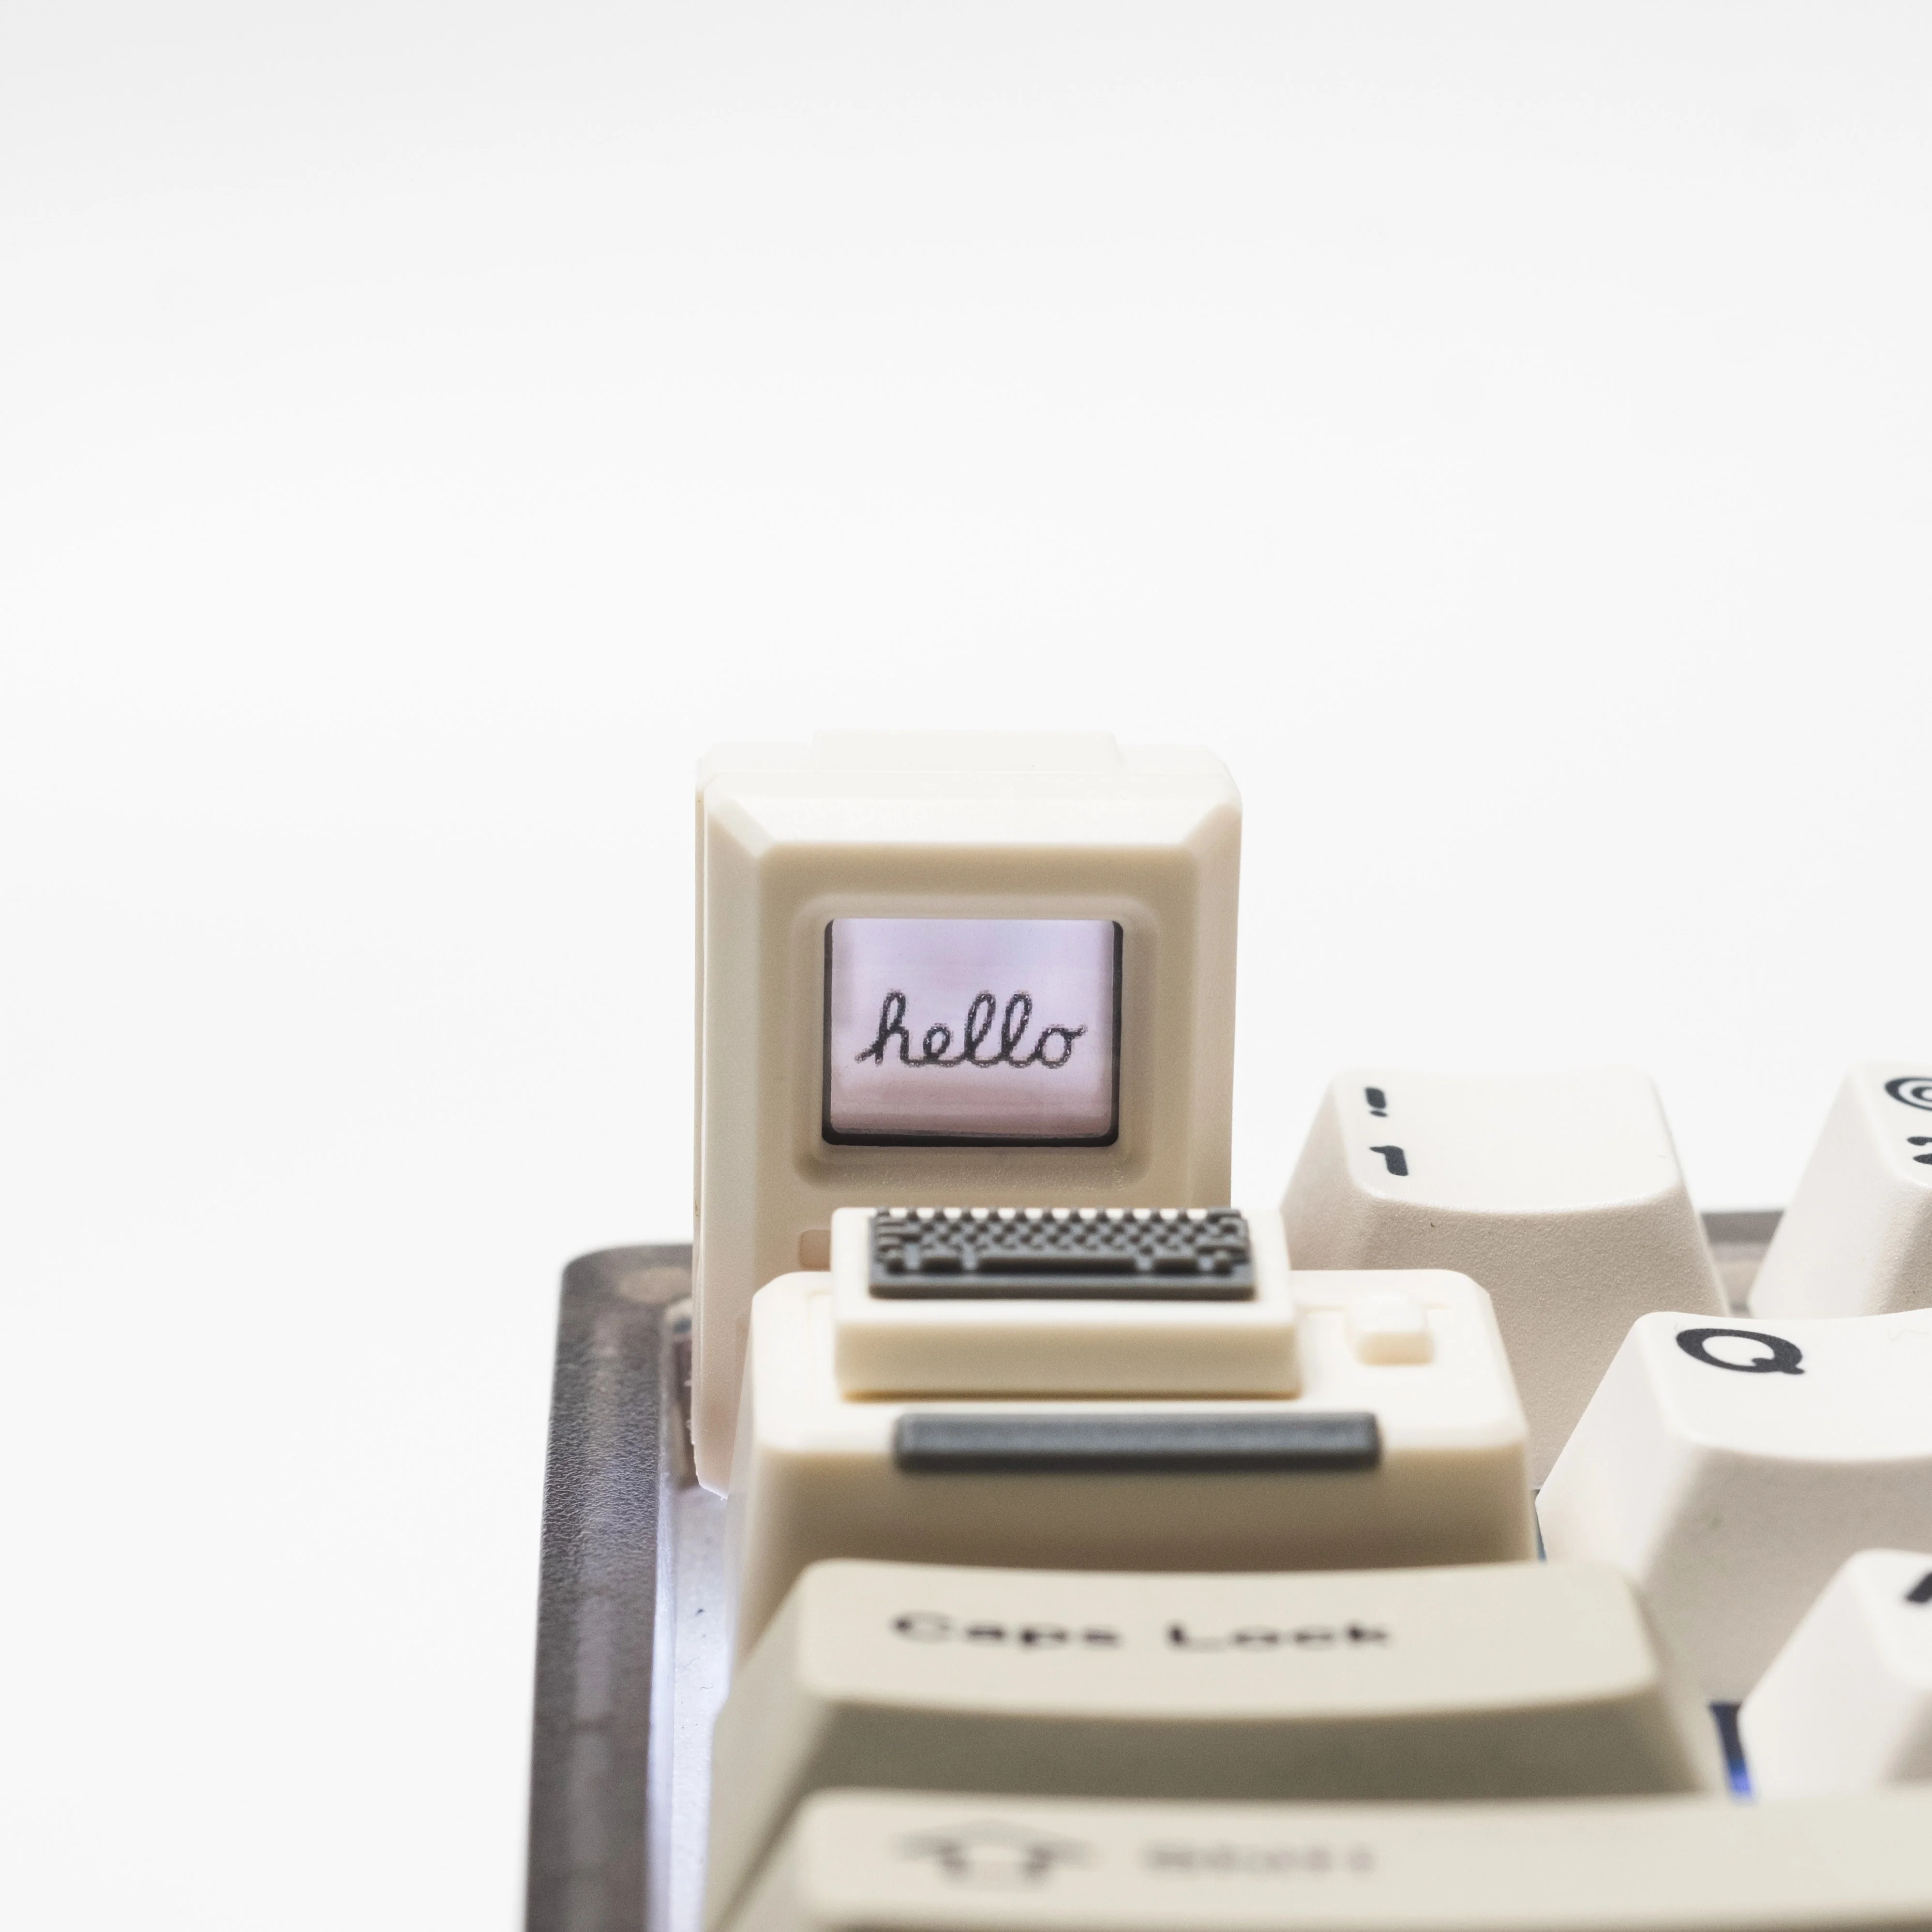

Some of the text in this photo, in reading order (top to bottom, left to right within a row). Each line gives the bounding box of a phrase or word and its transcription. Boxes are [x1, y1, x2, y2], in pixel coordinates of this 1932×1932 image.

[854, 989, 1087, 1068] hello
[1365, 1087, 1388, 1117] !
[1369, 1145, 1408, 1176] 1
[1676, 1328, 1805, 1375] Q
[893, 1611, 1390, 1650] Caps Lock
